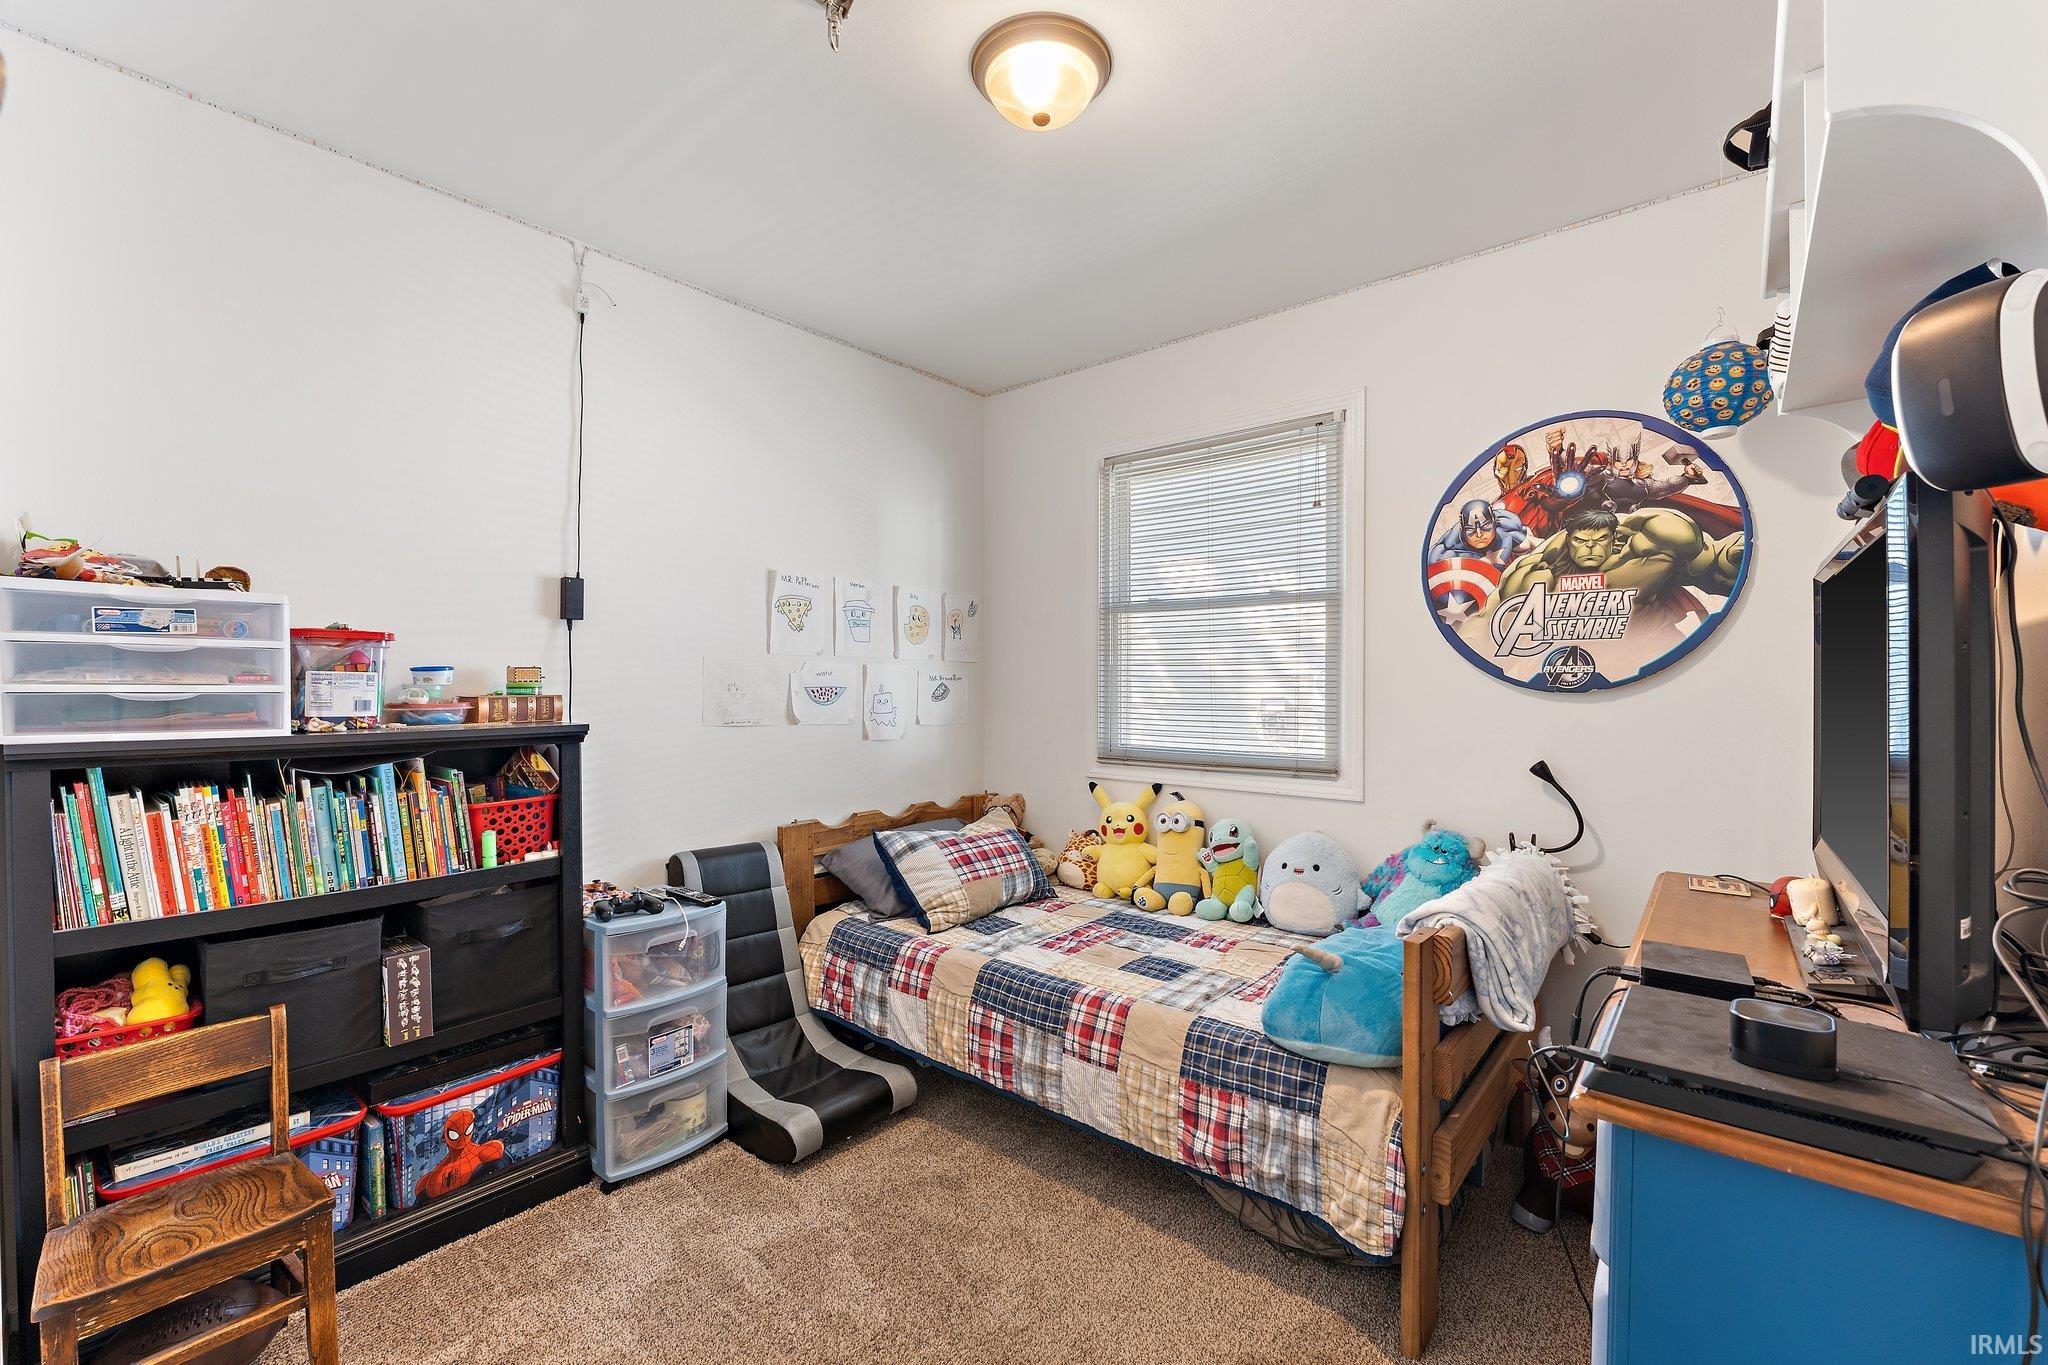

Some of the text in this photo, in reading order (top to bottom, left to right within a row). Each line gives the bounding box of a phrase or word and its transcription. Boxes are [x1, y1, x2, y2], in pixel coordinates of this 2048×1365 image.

[1561, 575, 1604, 592] MARVEL
[1543, 665, 1594, 673] AVENGERS
[382, 768, 394, 791] Usborne
[386, 792, 396, 812] Stories
[400, 807, 409, 827] QUINN
[118, 833, 136, 853] Light
[220, 843, 228, 862] Snow
[126, 859, 138, 872] the
[126, 871, 142, 890] Attic
[500, 1100, 552, 1130] SPIDER-MAN
[194, 1128, 256, 1152] WORLD'S GREATEST
[206, 1138, 246, 1154] FAIRY TALES
